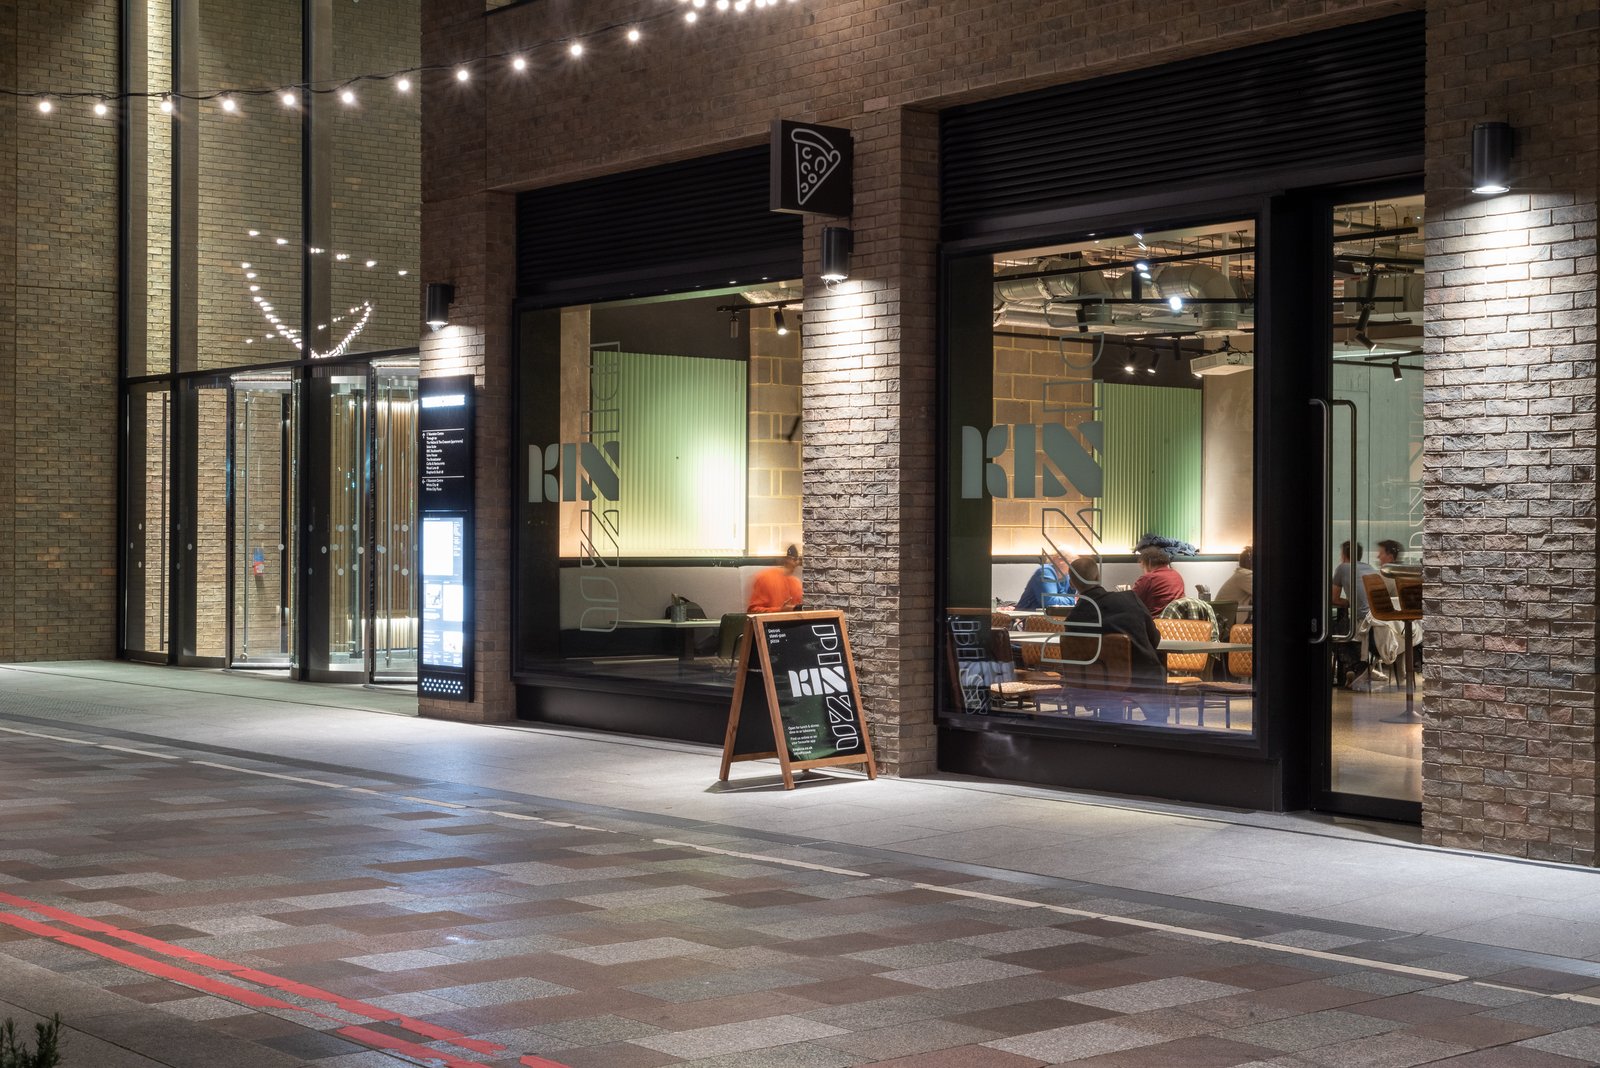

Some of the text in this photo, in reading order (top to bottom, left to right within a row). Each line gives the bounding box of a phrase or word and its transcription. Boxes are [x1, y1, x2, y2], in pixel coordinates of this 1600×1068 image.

[528, 441, 621, 503] KIN
[961, 422, 1104, 499] KIN
[788, 666, 849, 698] KIN
